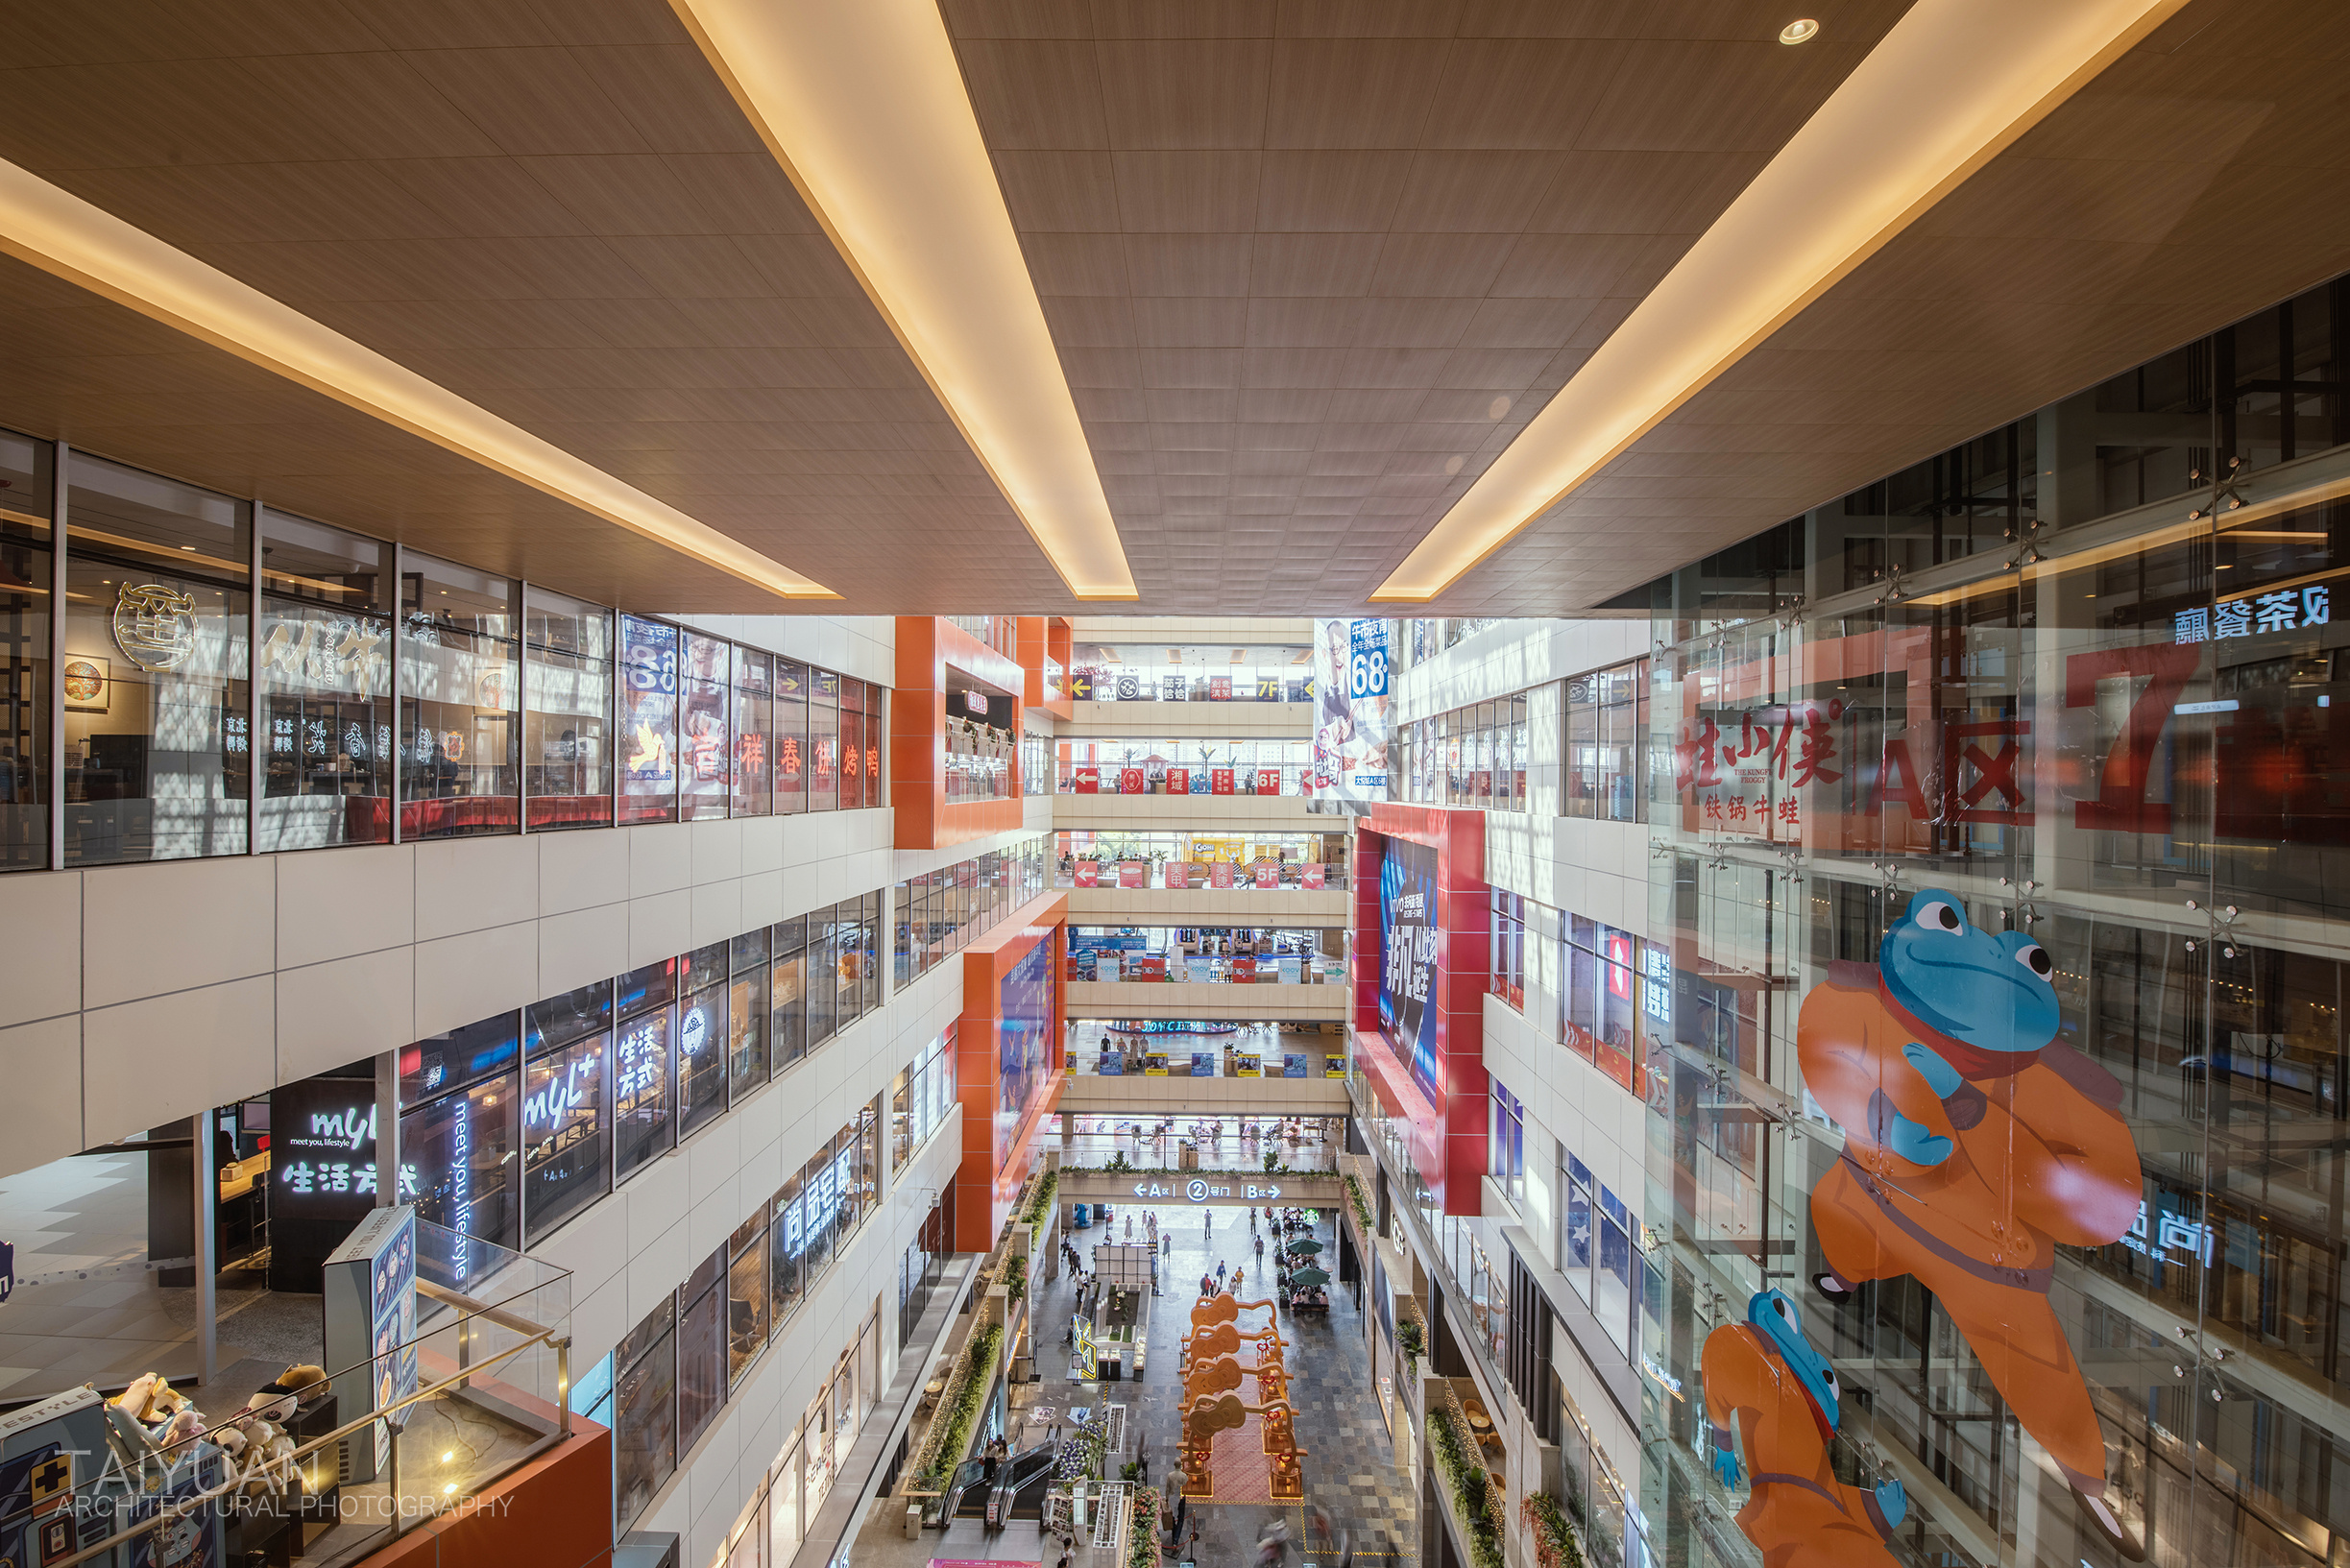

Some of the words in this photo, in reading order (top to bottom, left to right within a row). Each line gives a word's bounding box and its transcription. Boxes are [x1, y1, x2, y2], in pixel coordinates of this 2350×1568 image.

[1351, 651, 1384, 695] 68
[1257, 681, 1278, 697] 7F
[1258, 774, 1279, 787] 6F
[1705, 794, 1800, 825] 铁锅牛蛙
[1171, 864, 1183, 887] 美甲
[1257, 868, 1277, 881] 5F
[618, 1025, 654, 1064] 生活
[618, 1055, 653, 1098] 方式
[455, 1101, 468, 1156] meet
[324, 1139, 351, 1148] lifestyle
[1149, 1183, 1170, 1197] A区
[1248, 1185, 1266, 1198] B区
[452, 1201, 471, 1281] lifestyle
[0, 1391, 92, 1430] ESTYLE
